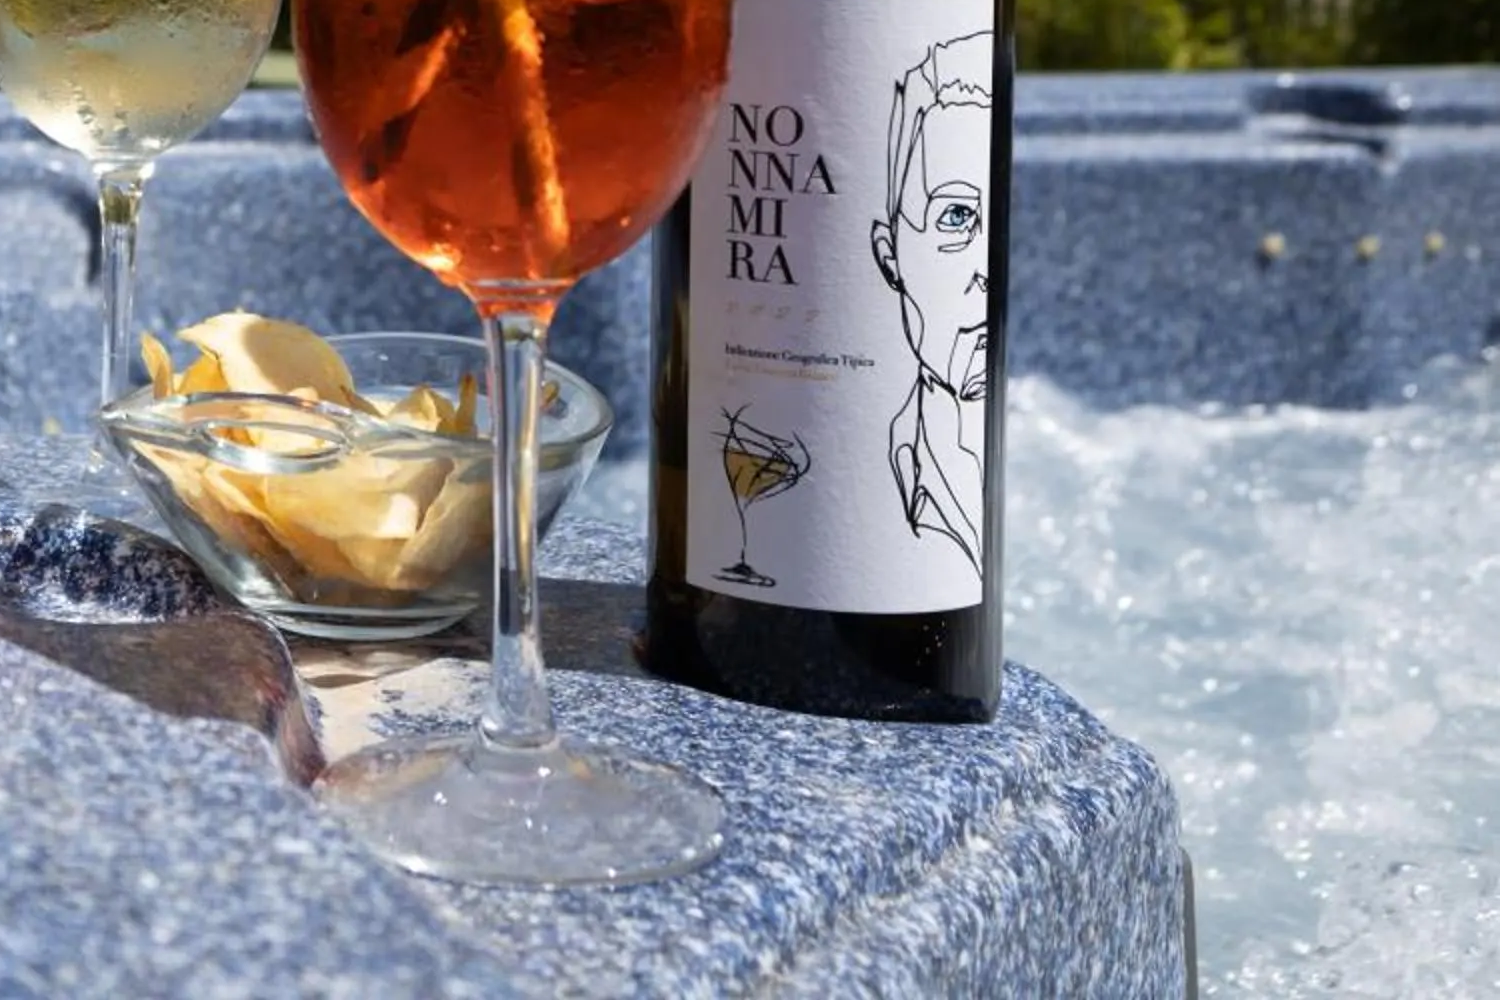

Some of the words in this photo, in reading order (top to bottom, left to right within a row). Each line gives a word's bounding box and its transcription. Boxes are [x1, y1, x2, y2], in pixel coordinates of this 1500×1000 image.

[728, 103, 804, 147] NO
[728, 148, 838, 195] NNA
[726, 194, 788, 238] MI
[726, 239, 800, 286] RA
